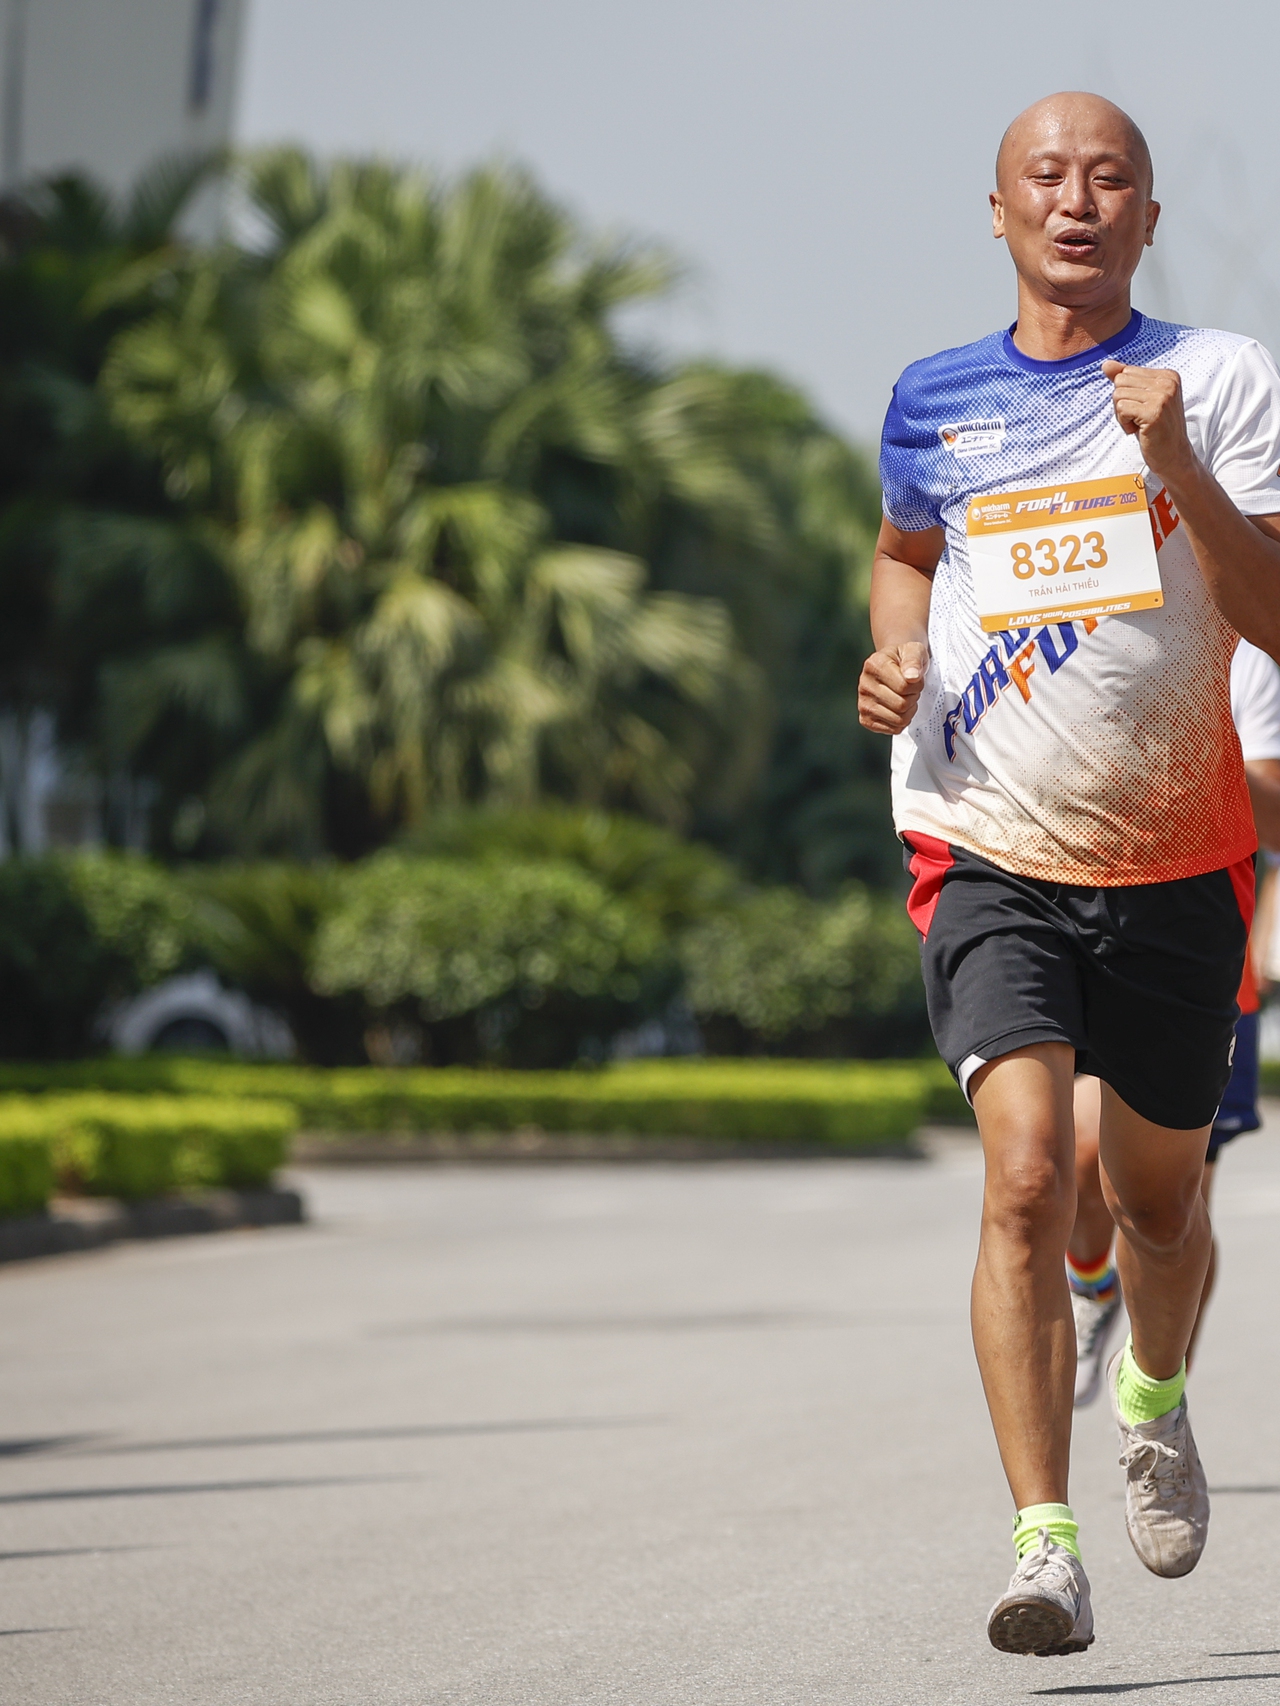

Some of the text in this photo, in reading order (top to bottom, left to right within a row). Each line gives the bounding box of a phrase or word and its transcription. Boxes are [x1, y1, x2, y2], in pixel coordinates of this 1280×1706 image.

[957, 421, 1001, 433] unicharm
[981, 503, 1011, 513] unicharm
[1015, 497, 1053, 514] FOR
[1049, 495, 1118, 515] FUTURE
[1119, 491, 1138, 505] 2025
[1010, 531, 1109, 580] 8323
[1008, 602, 1132, 626] LOVE YOUR POSSIBILITIES
